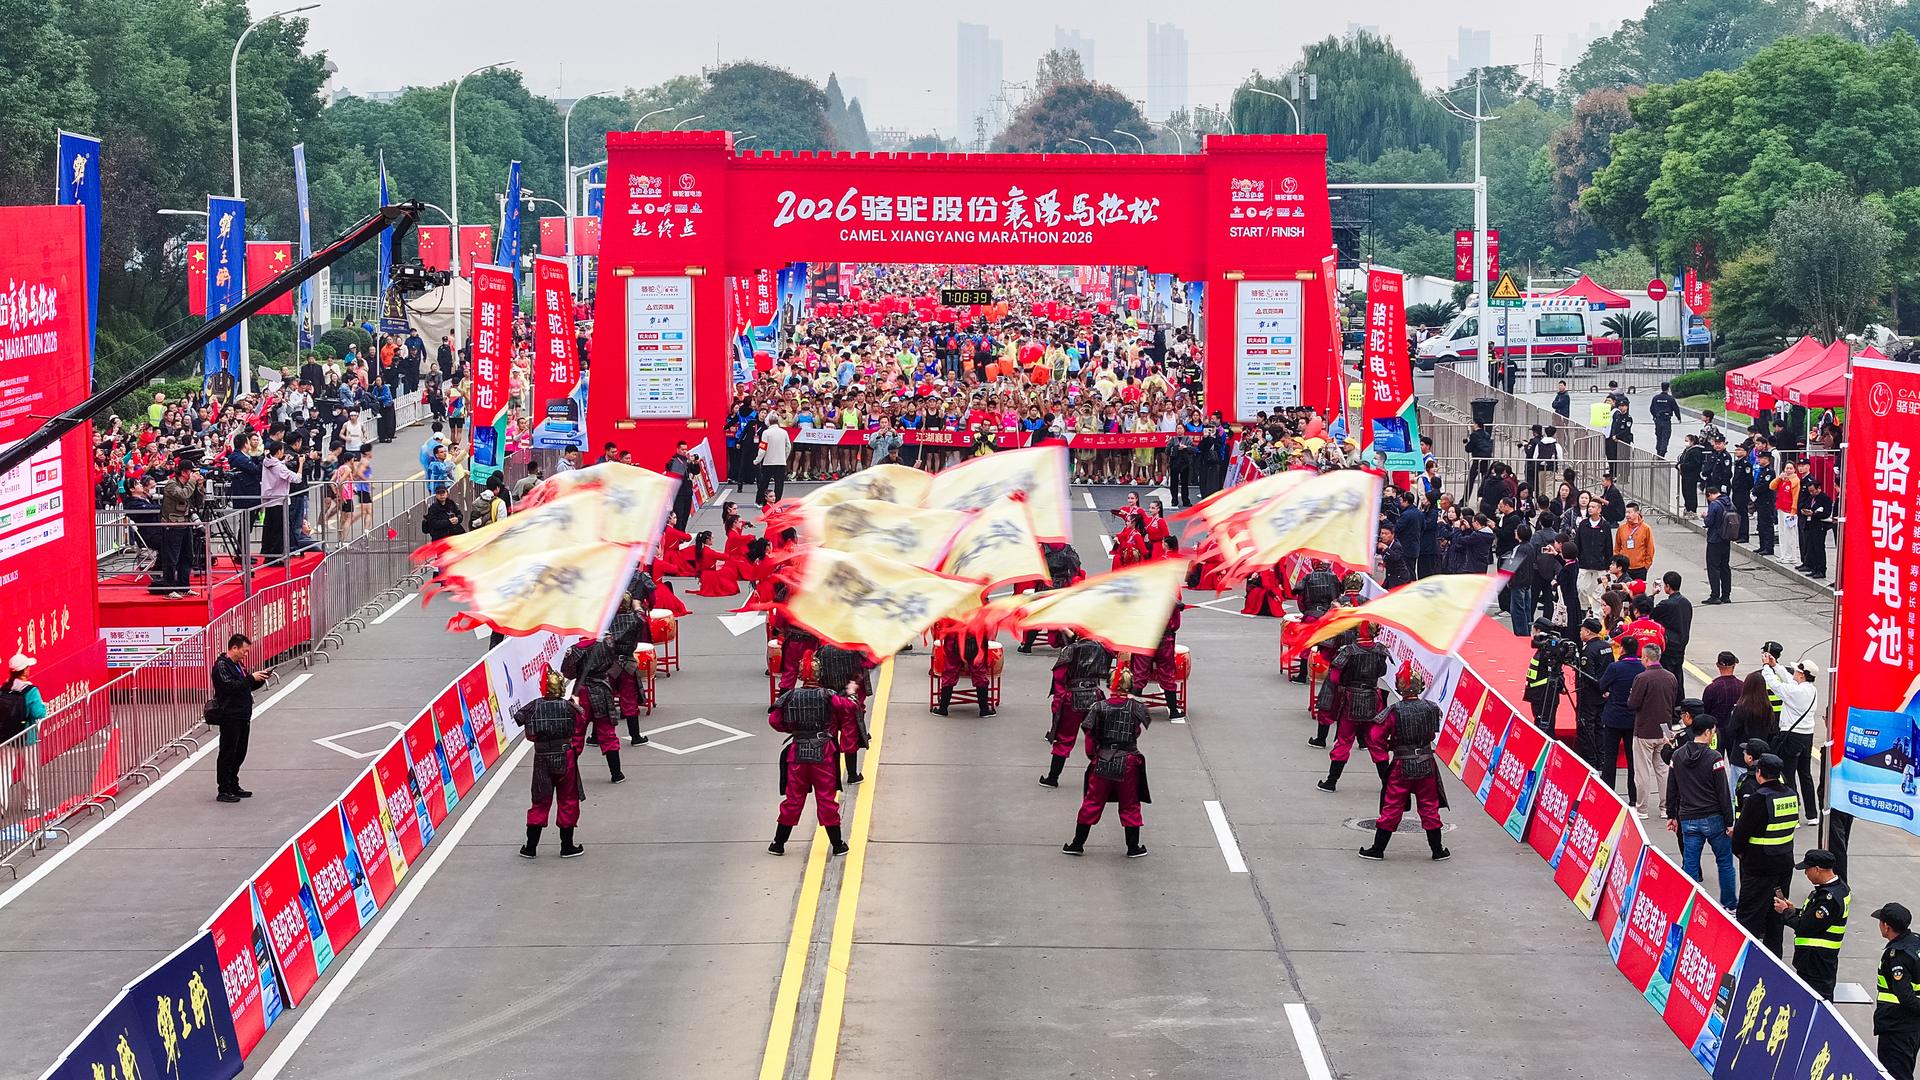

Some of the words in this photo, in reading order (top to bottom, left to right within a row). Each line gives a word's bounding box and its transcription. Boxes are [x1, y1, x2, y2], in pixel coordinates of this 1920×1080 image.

[840, 229, 887, 243] CAMEL
[890, 230, 975, 243] XIANGYANG
[978, 230, 1059, 244] MARATHON
[1062, 230, 1093, 244] 2026
[1230, 227, 1264, 238] START
[1271, 227, 1305, 238] FINISH
[946, 292, 987, 304] 7:08:39
[5, 333, 43, 361] MARATHON
[44, 331, 58, 354] 2026
[476, 302, 495, 409] 骆驼电池
[546, 289, 567, 384] 骆驼电池
[1370, 303, 1392, 401] 骆驼电池
[1899, 388, 1920, 400] CA
[1863, 441, 1910, 667] 骆驼电池
[1497, 749, 1525, 790] 骆驼电池
[387, 781, 413, 826] 骆驼电池
[1540, 779, 1569, 824] 骆驼电池
[356, 816, 385, 864] 骆驼电池
[1570, 813, 1599, 861] 骆驼电池
[312, 854, 348, 907] 骆驼电池
[270, 897, 304, 955] 骆驼电池
[1632, 890, 1667, 948] 骆驼电池
[1680, 938, 1717, 1001] 骆驼电池
